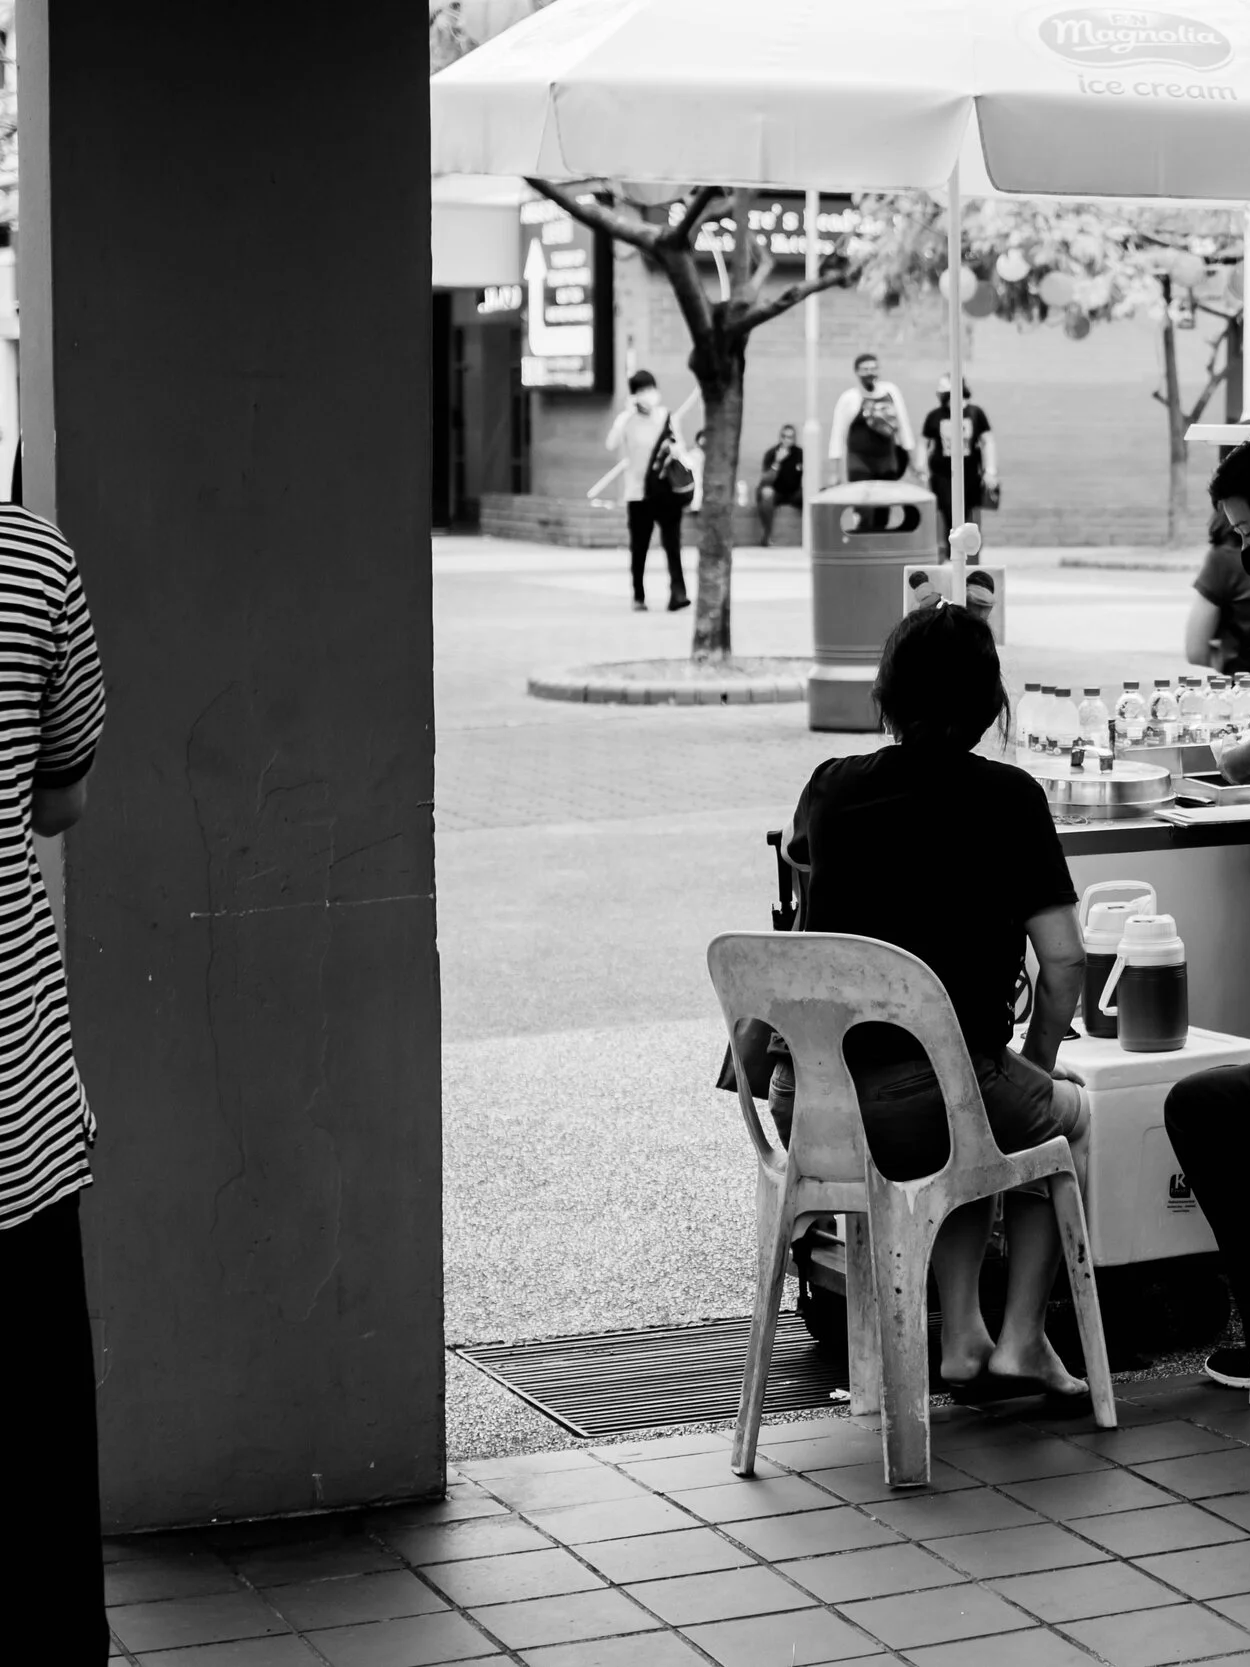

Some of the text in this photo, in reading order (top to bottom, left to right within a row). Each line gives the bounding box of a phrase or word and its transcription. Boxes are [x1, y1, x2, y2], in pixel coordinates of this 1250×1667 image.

[1051, 18, 1223, 54] Magnolia
[1077, 74, 1238, 101] ice cream
